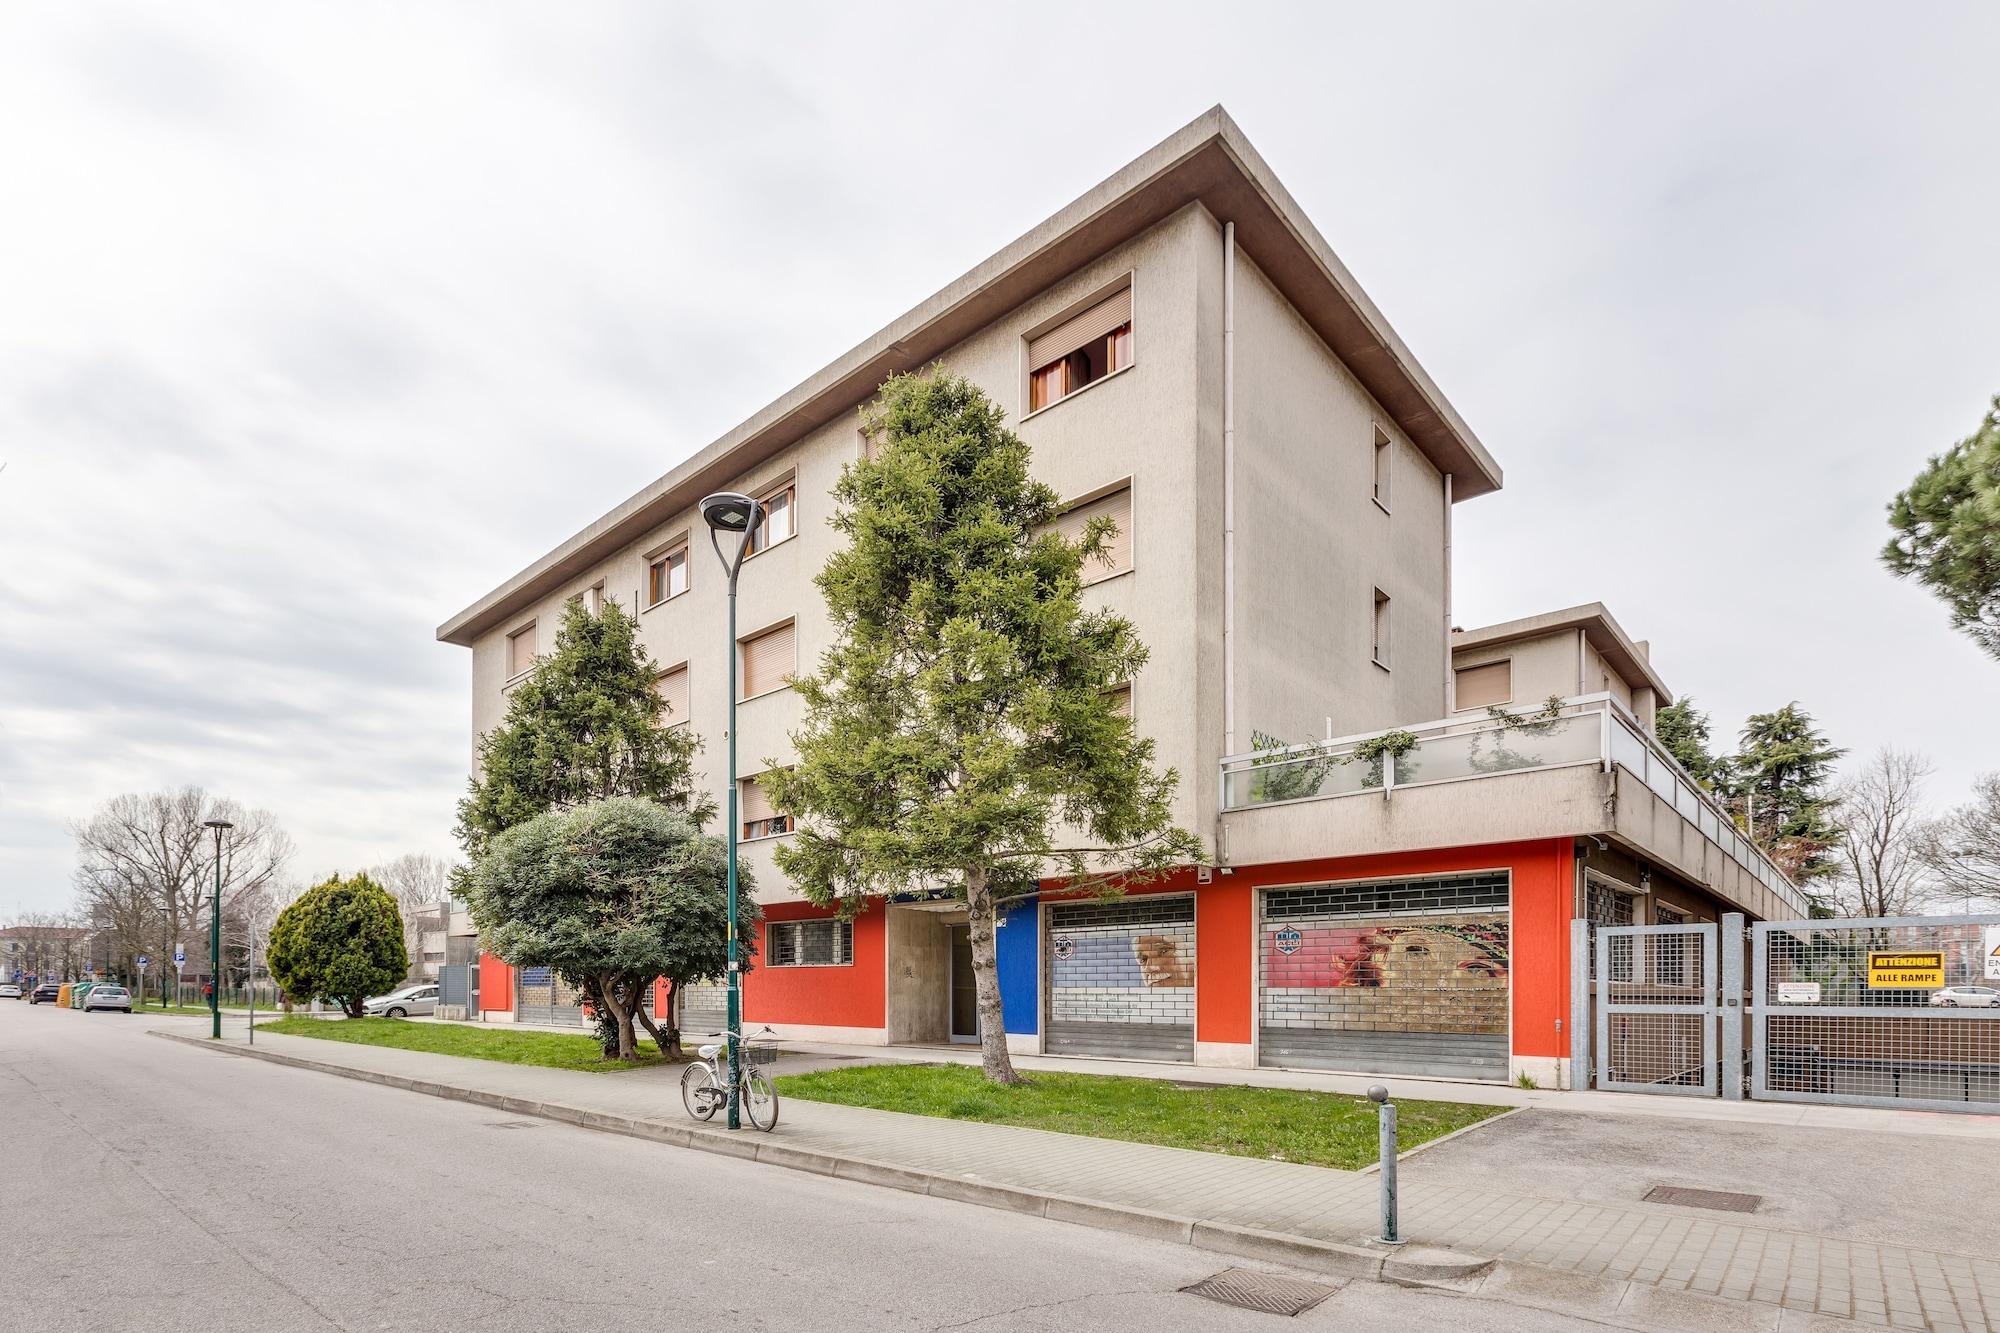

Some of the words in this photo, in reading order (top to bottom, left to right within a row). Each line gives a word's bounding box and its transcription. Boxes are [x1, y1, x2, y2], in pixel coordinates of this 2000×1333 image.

[1875, 957, 1939, 967] ATTENZIONE
[1876, 974, 1898, 982] ALLE
[1901, 974, 1937, 982] RAMPE
